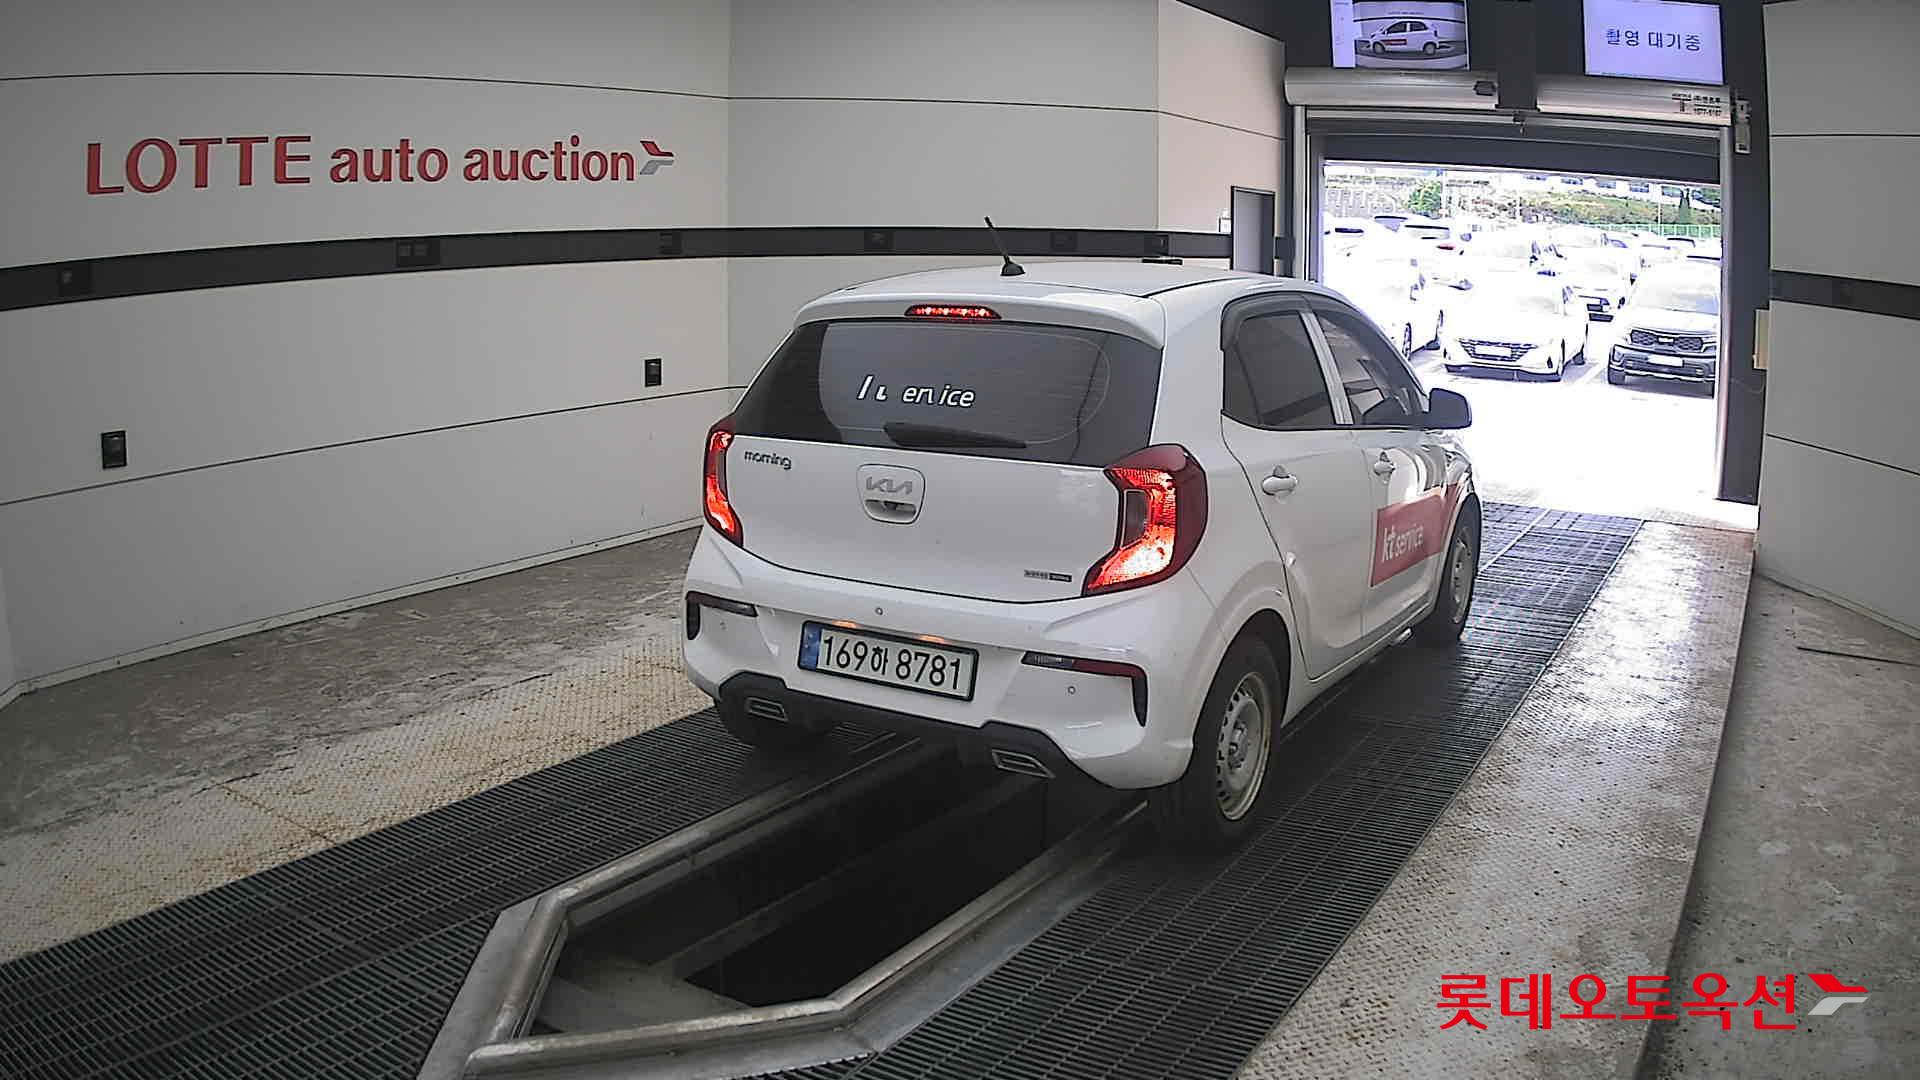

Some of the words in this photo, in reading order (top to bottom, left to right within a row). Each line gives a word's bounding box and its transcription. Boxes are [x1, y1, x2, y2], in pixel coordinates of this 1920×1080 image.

[1606, 28, 1640, 48] 촬영
[1647, 31, 1701, 52] 대기중
[86, 135, 312, 195] LOTTE
[329, 138, 449, 184] auto
[463, 134, 635, 184] auction
[744, 450, 792, 471] morning
[866, 476, 913, 495] KIA
[823, 635, 890, 676] 169하
[895, 648, 961, 690] 8781
